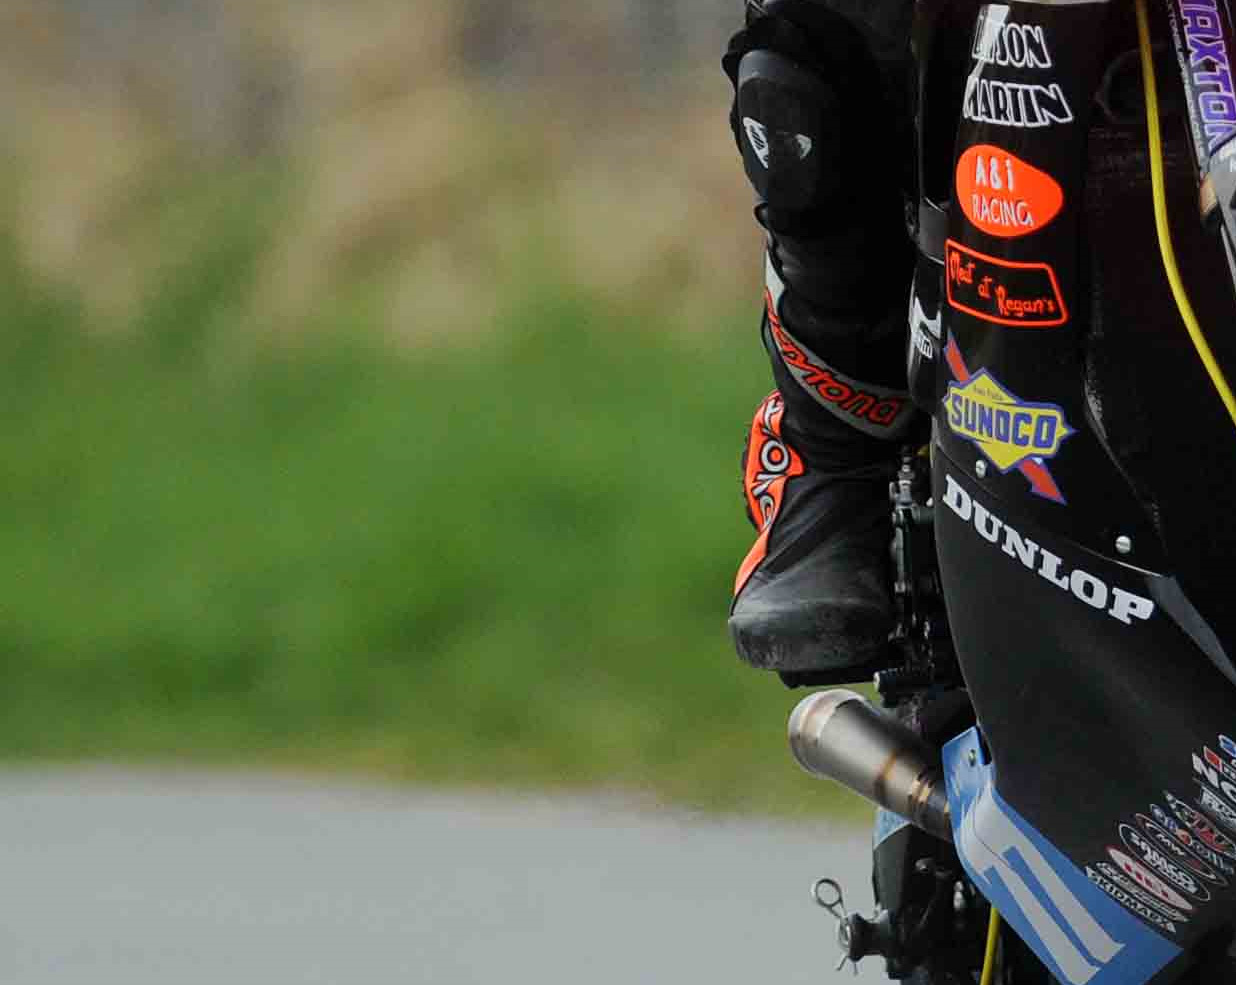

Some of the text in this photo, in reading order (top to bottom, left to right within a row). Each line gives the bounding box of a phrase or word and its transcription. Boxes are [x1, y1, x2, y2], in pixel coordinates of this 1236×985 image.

[970, 193, 1035, 229] RACING
[950, 391, 1059, 450] SUNOCO
[943, 474, 1156, 626] DUNLOP
